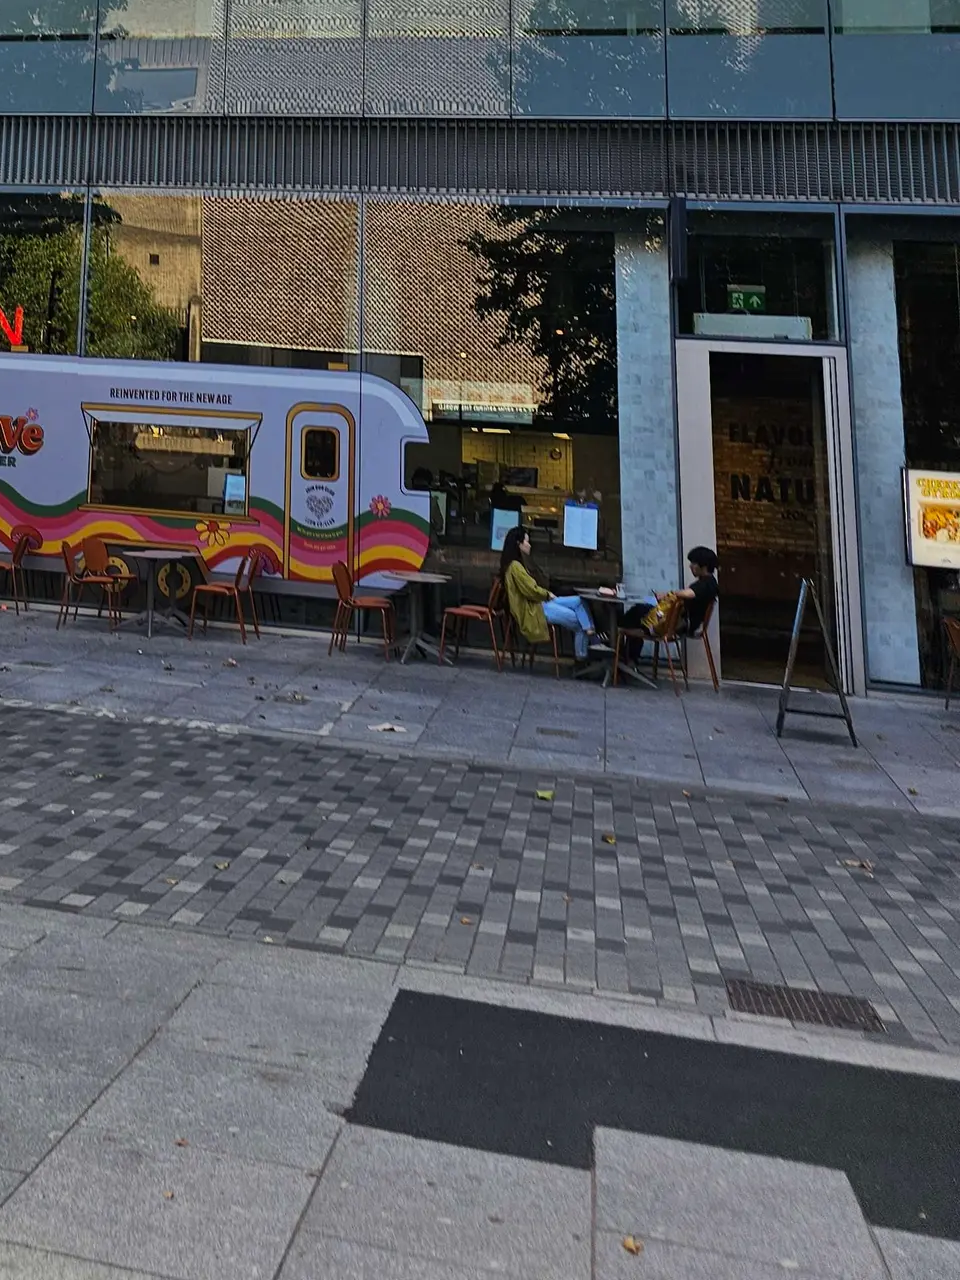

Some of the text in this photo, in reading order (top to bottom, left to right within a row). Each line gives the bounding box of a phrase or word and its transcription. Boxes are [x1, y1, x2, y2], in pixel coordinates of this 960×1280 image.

[110, 387, 232, 405] REINVENTED FOR THE NEW AGE
